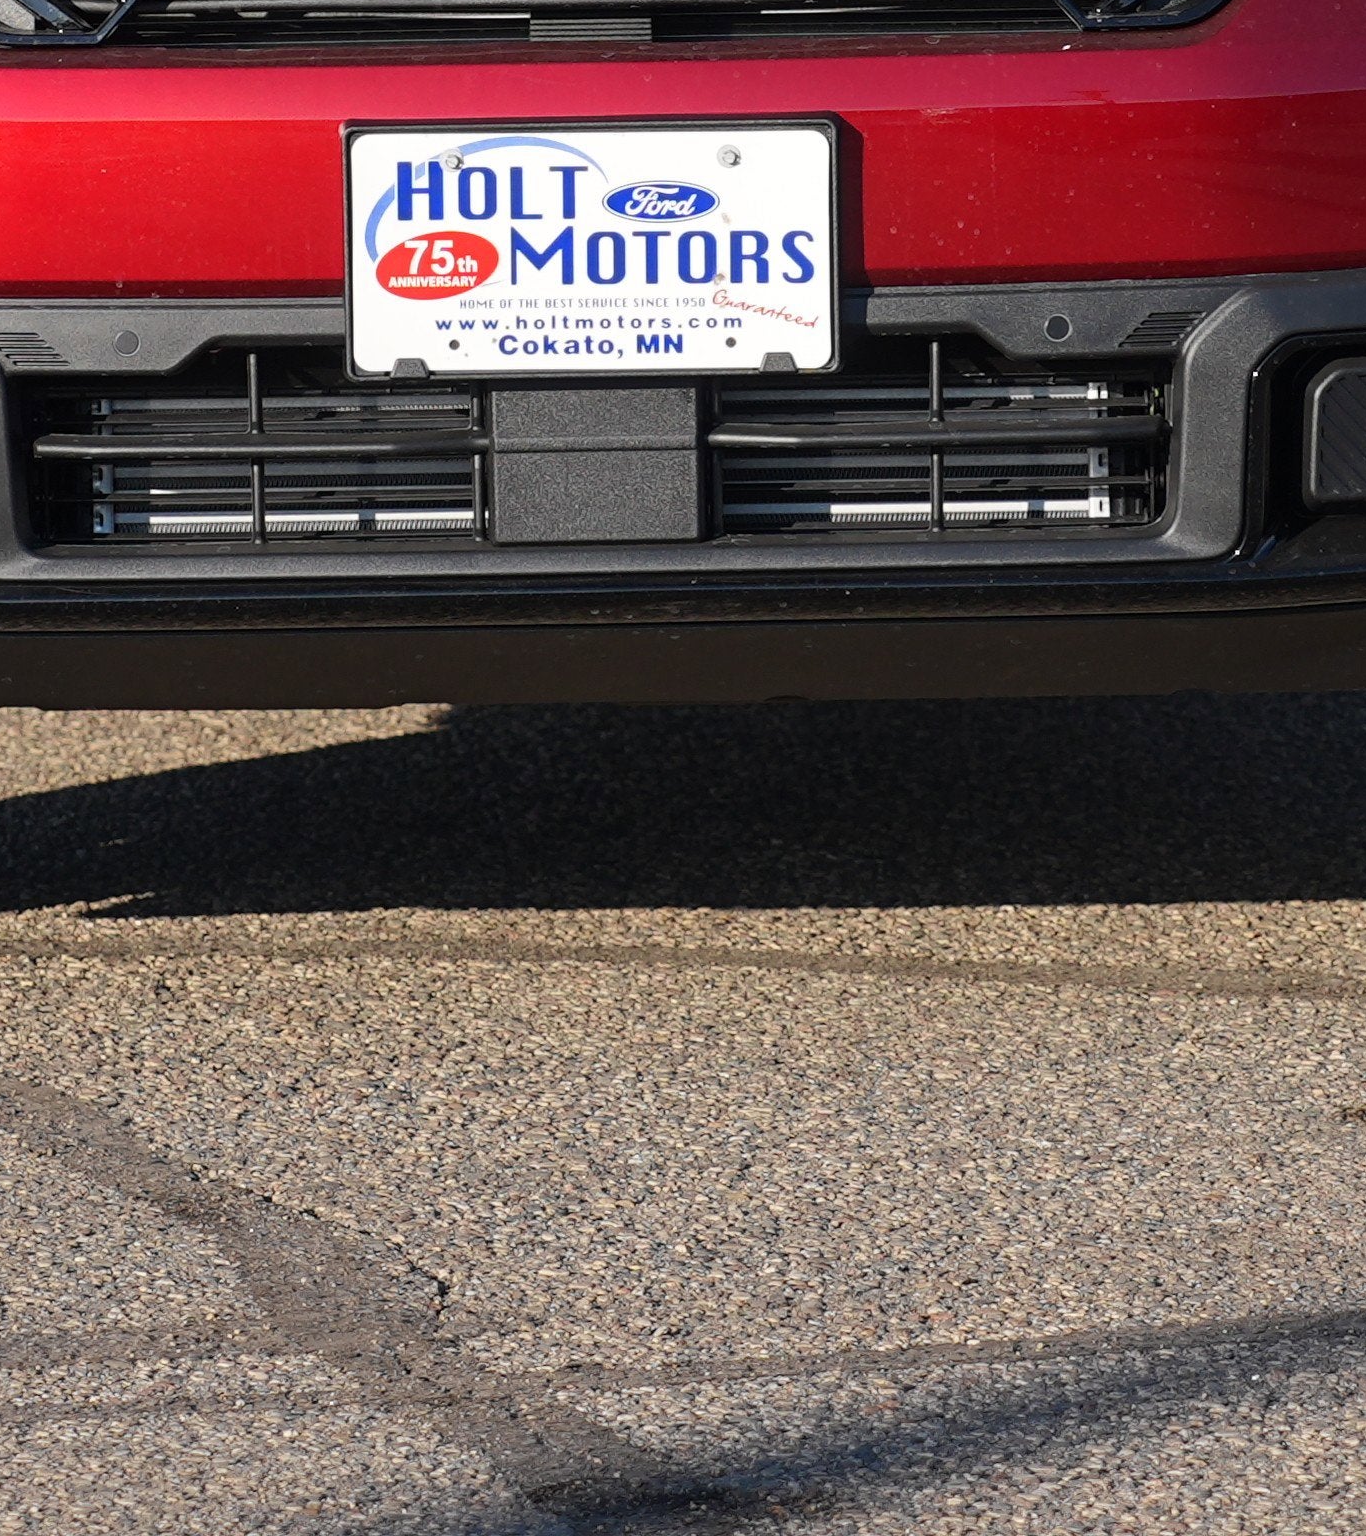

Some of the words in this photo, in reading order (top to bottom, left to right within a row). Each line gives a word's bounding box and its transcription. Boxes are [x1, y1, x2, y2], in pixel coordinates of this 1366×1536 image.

[397, 161, 589, 221] HOLT
[623, 185, 696, 217] Ford
[404, 239, 479, 276] 75th
[510, 225, 816, 285] MOTORS
[388, 276, 477, 288] ANNIVERSARY
[459, 299, 495, 310] HOME
[499, 298, 514, 309] OF
[519, 298, 540, 309] THE
[545, 298, 573, 309] BEST
[578, 298, 629, 308] SERVICE
[633, 297, 668, 308] SINCE
[676, 297, 706, 308] 1950
[712, 289, 819, 329] Guaranteed
[435, 315, 743, 331] www.holtmotors.com
[498, 334, 624, 359] Cokato,
[636, 334, 683, 354] MN
